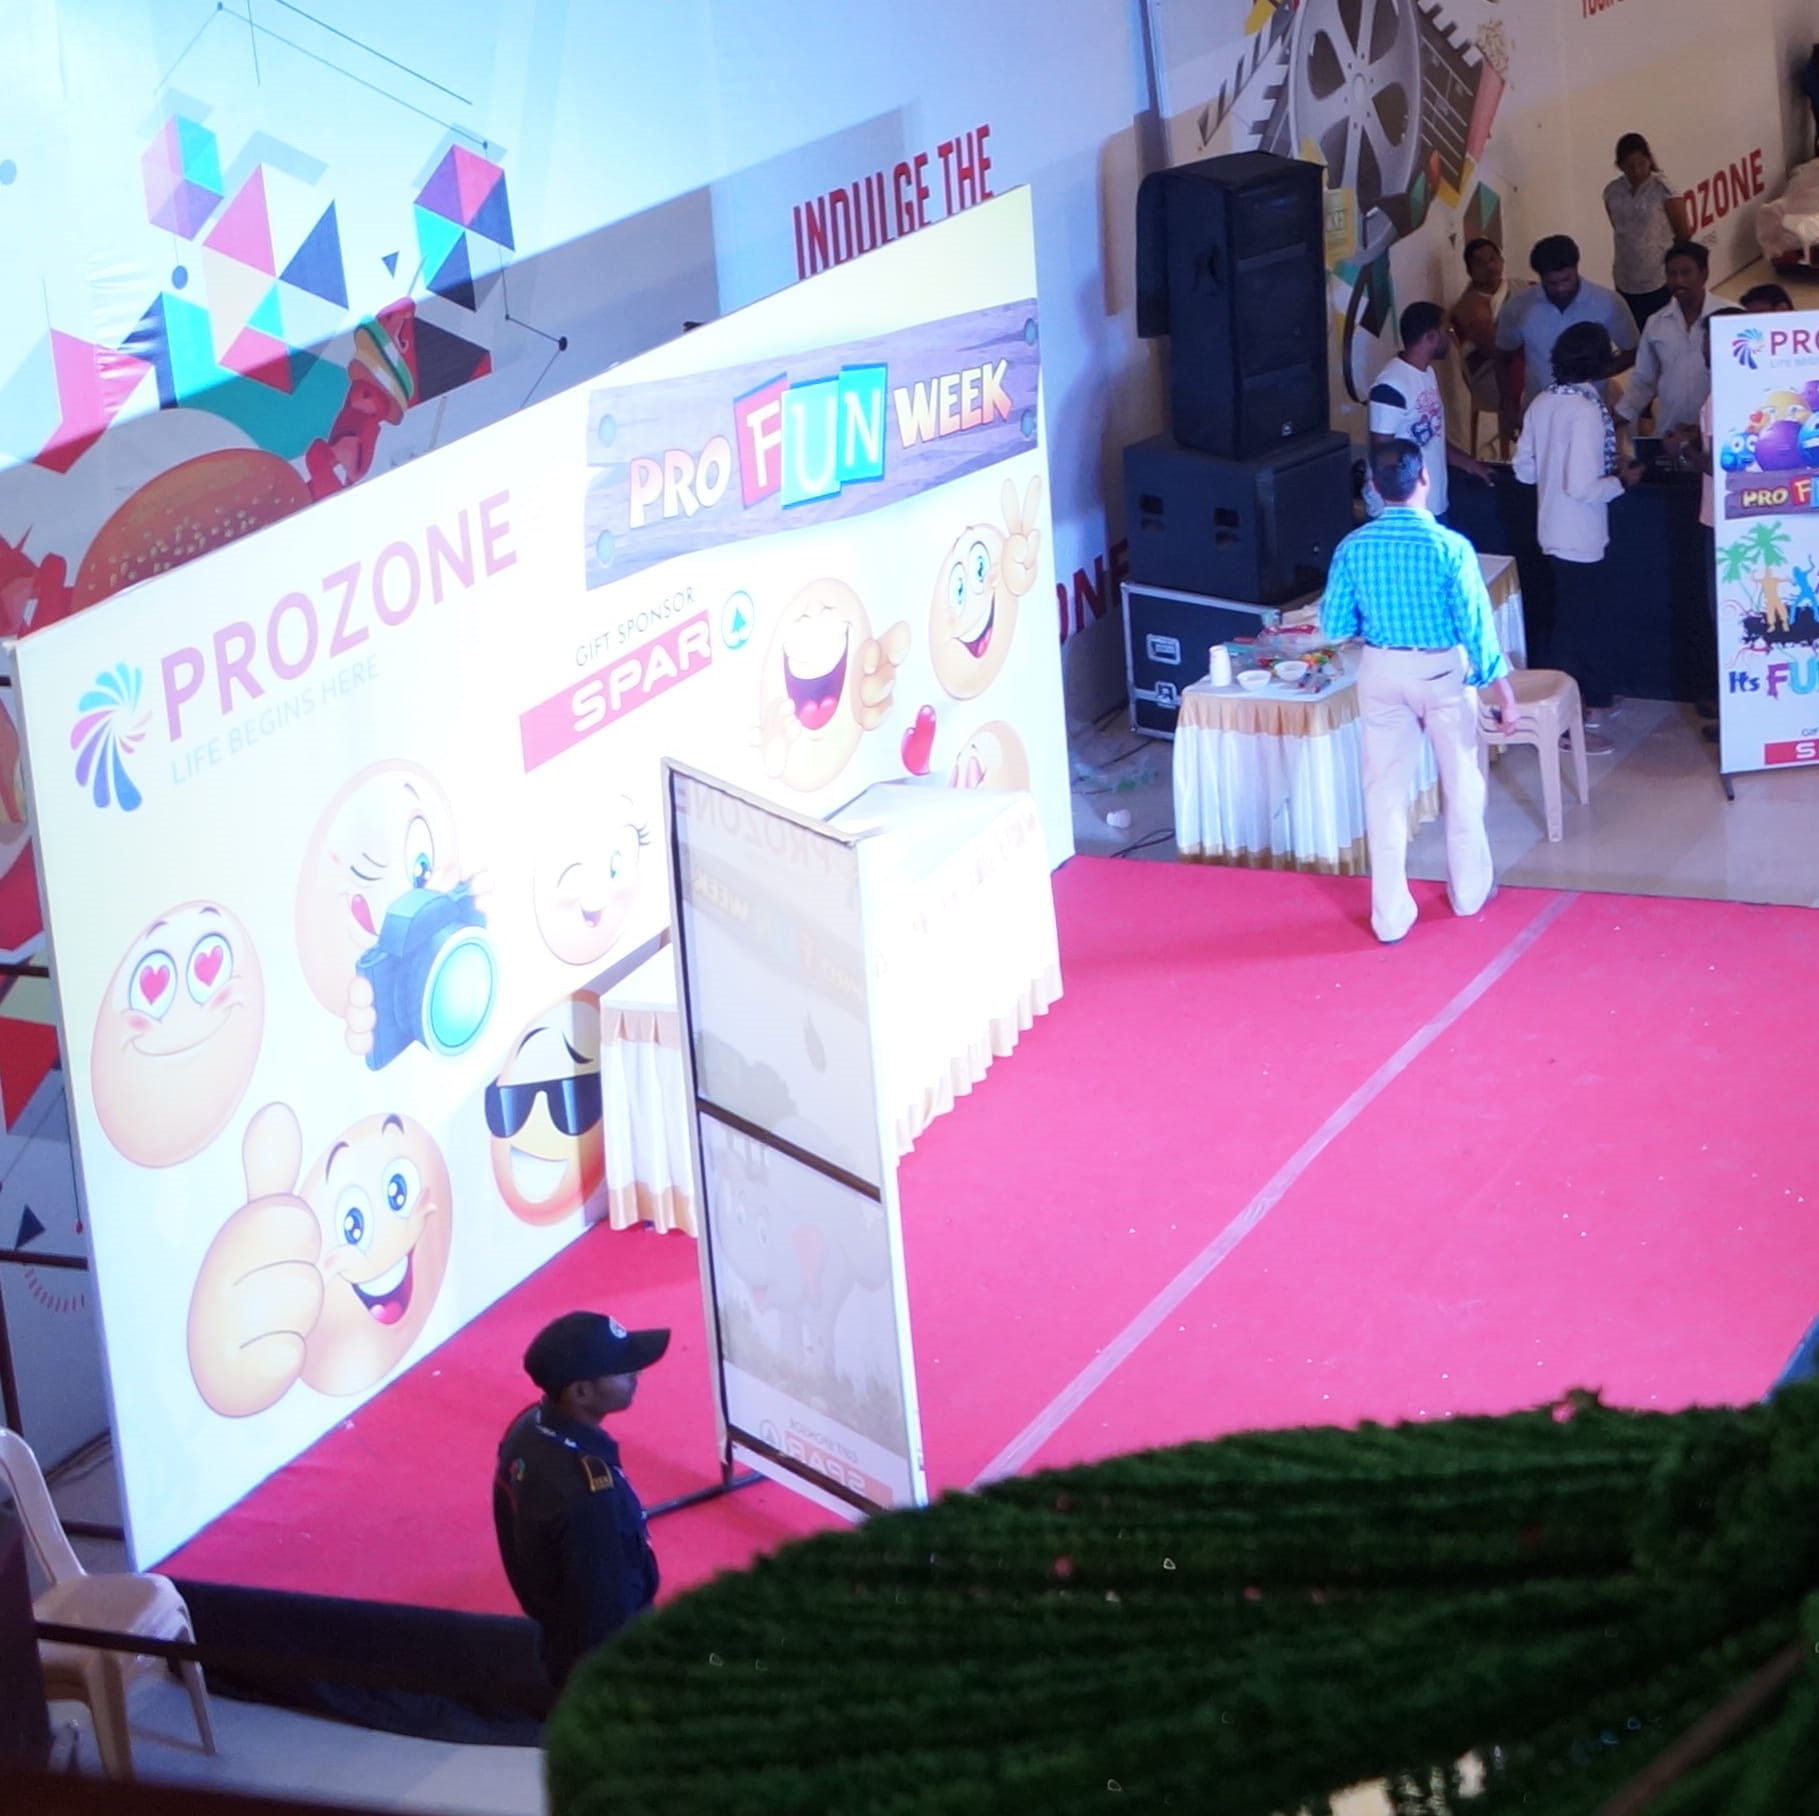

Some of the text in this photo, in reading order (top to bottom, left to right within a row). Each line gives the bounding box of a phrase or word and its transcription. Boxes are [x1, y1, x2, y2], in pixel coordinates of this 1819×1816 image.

[792, 124, 993, 279] INDULGE THE
[1683, 148, 1765, 238] OZONE
[630, 359, 1012, 529] PRO FUN WEEK
[1743, 488, 1787, 507] PRO
[161, 489, 517, 742] PROZONE
[575, 588, 697, 666] GIFT SPONSOR
[170, 654, 379, 785] LIFE BEGINS HERE
[570, 618, 712, 732] SPAR
[1729, 670, 1760, 694] It's
